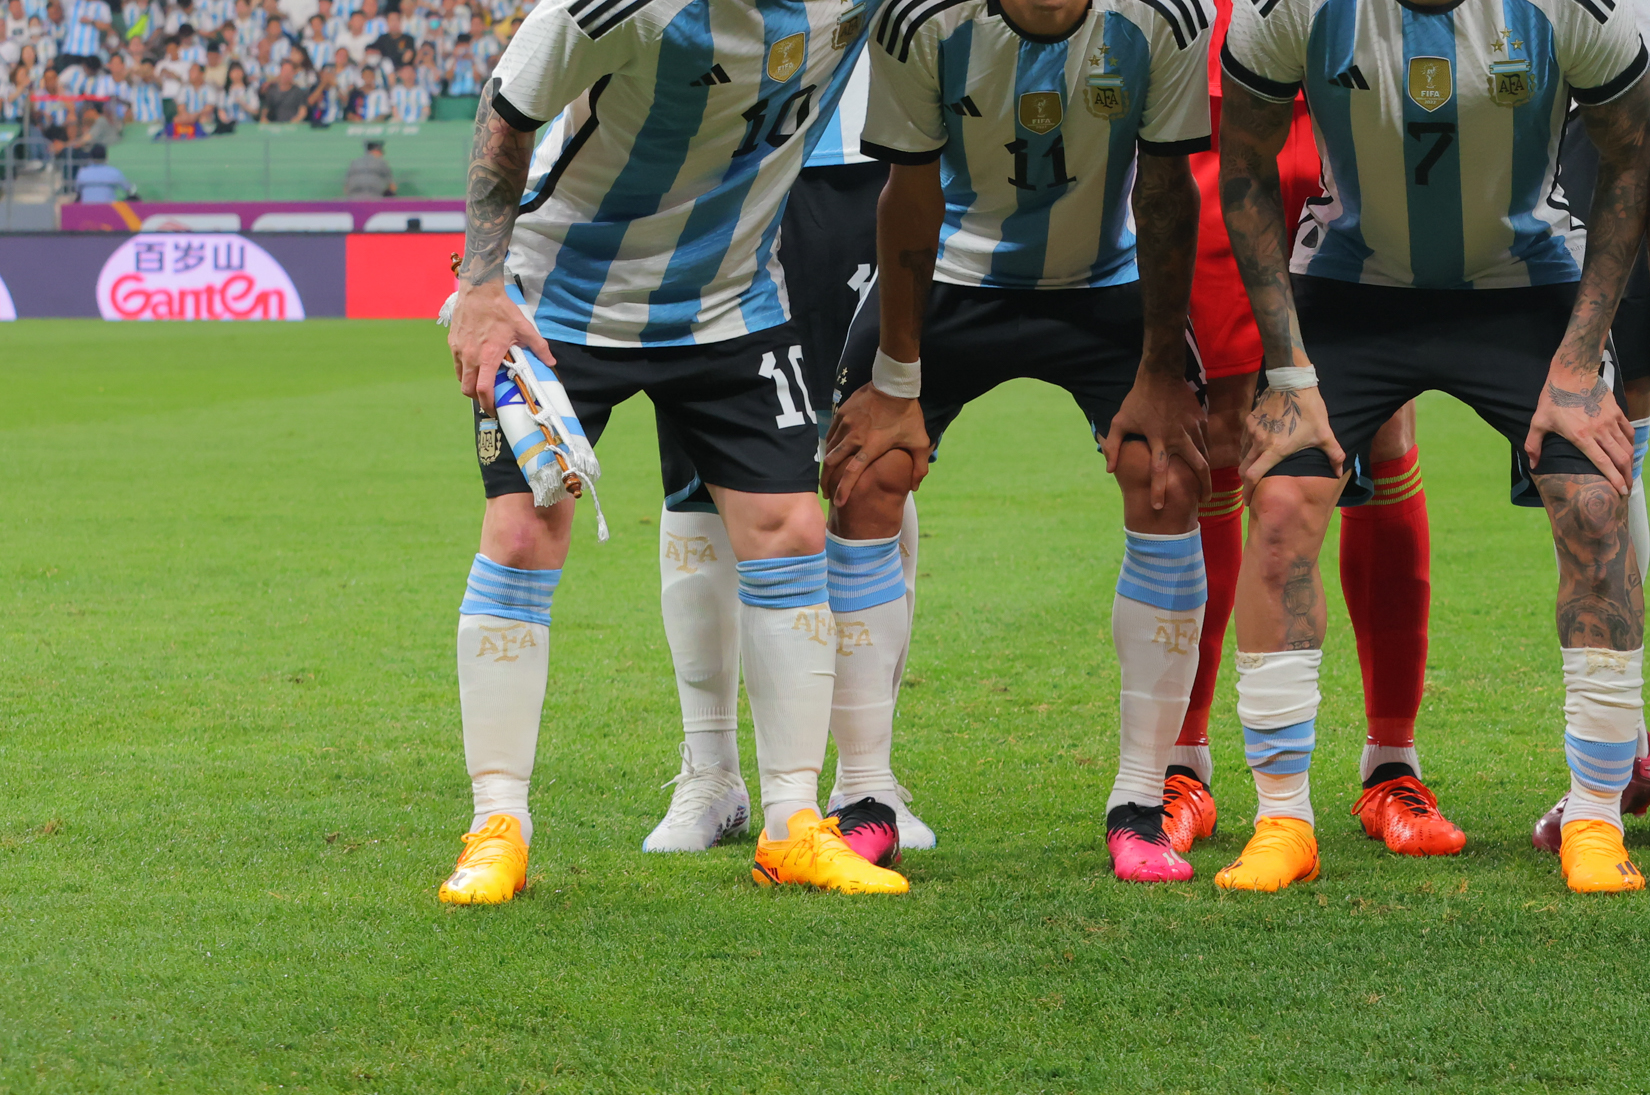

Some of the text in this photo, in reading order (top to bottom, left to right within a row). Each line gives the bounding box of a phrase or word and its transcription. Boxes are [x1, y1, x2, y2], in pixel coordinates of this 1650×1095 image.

[1094, 87, 1119, 108] AFA
[1421, 90, 1440, 98] FIFA
[1499, 74, 1526, 95] AFA
[731, 84, 817, 158] 10
[1004, 134, 1077, 191] 11
[1407, 121, 1455, 186] 7
[134, 242, 246, 273] 百岁山
[665, 531, 717, 573] AFA
[477, 622, 537, 663] AFA
